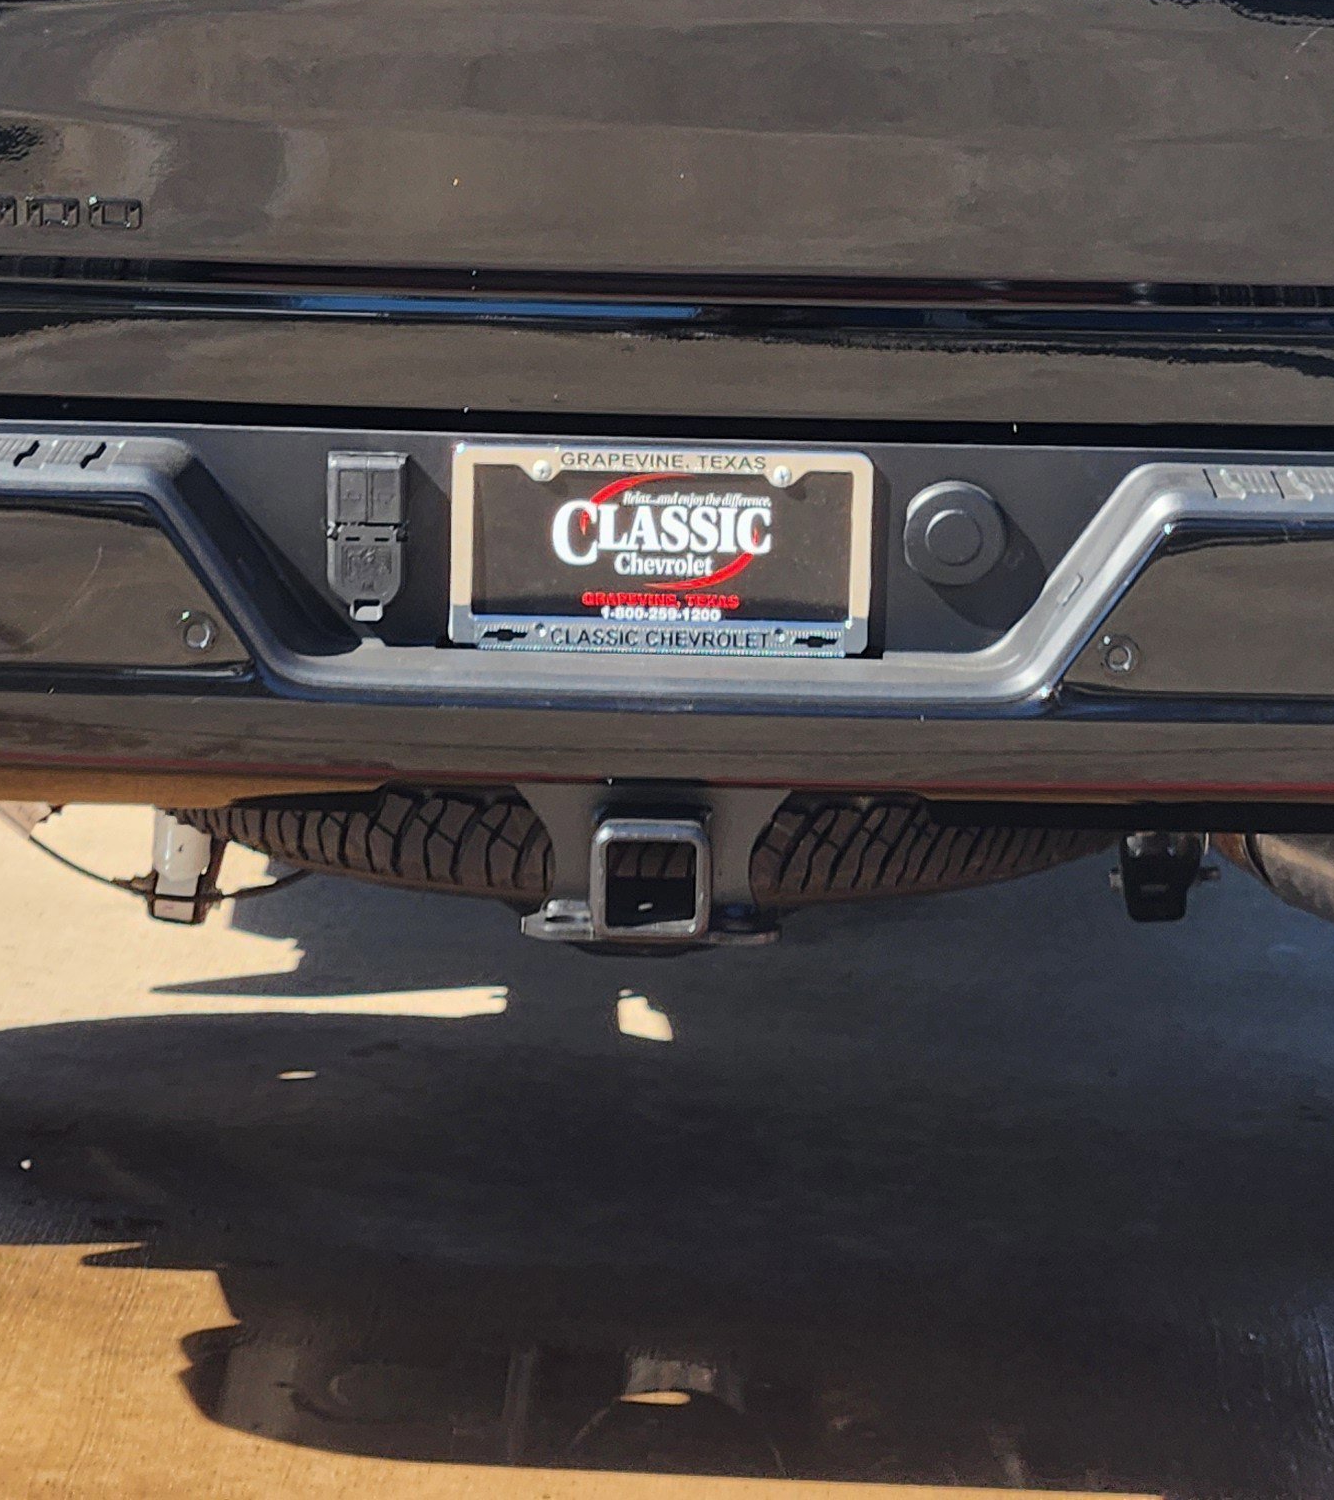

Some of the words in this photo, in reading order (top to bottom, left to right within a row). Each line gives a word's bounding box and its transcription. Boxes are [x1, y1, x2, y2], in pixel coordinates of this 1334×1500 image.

[697, 455, 767, 470] TEXAS
[678, 493, 704, 507] enjoy
[706, 493, 721, 506] the
[552, 500, 772, 566] CLASSIC
[614, 553, 713, 577] Chevrolet
[685, 594, 741, 609] TEXAS
[551, 627, 639, 647] CLASSIC
[645, 630, 769, 649] CHEVROLET
